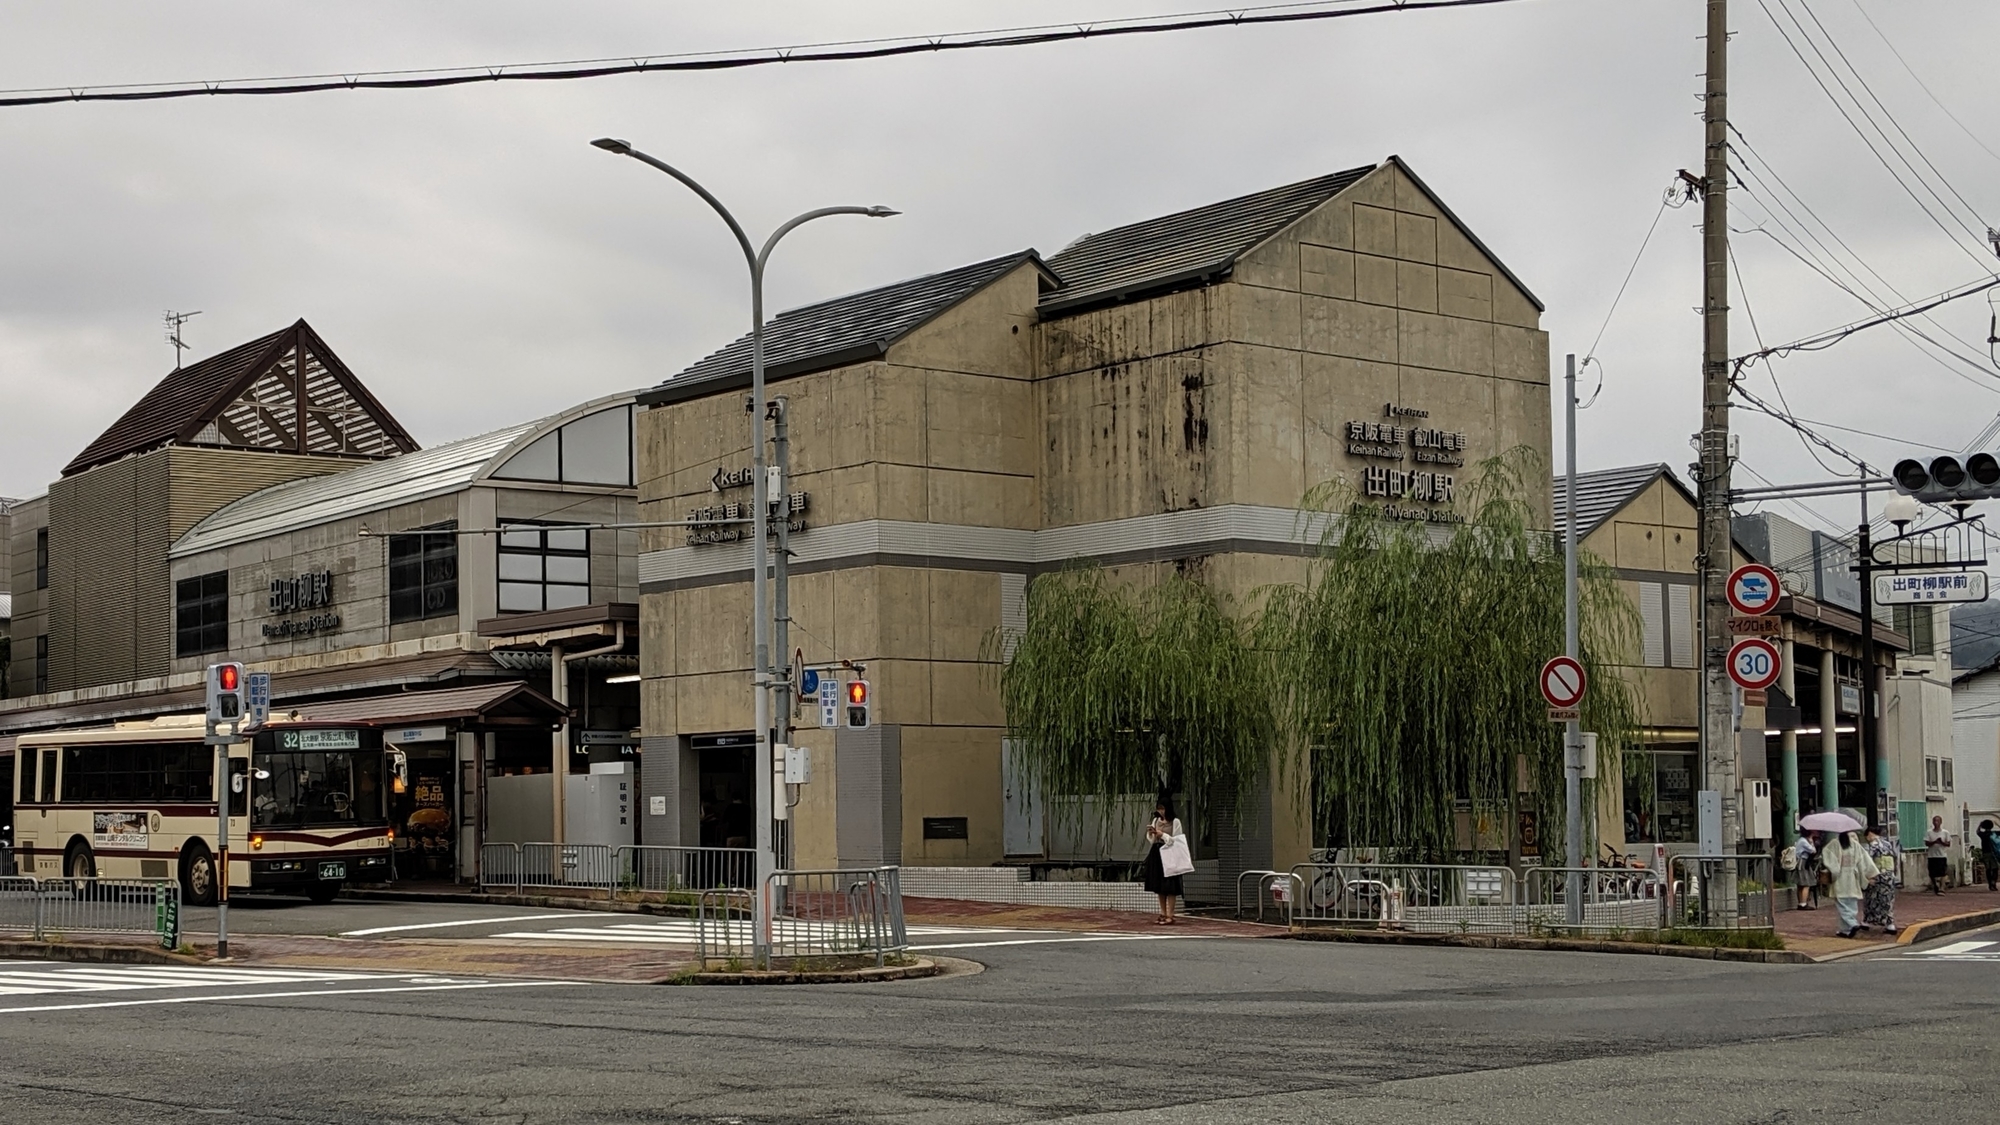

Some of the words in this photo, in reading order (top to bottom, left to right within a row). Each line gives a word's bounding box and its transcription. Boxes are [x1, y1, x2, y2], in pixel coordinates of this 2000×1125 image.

[1350, 420, 1406, 445] 京阪電車
[1414, 427, 1468, 452] 叡山電車
[1350, 444, 1376, 456] Keihan
[1377, 446, 1407, 461] Railway
[1417, 451, 1436, 463] Eizan
[1367, 465, 1455, 502] 出町柳駅
[270, 570, 330, 613] 出町柳駅
[1893, 575, 1968, 592] 出町柳駅前
[1913, 590, 1948, 600] 商店会
[1728, 620, 1779, 632] マイクロを除く
[1740, 653, 1769, 676] 30
[826, 708, 834, 725] 専用
[283, 732, 299, 748] 32
[414, 785, 444, 802] 絶品
[619, 782, 628, 826] 証明写真
[229, 819, 236, 828] 73
[376, 837, 385, 847] 73
